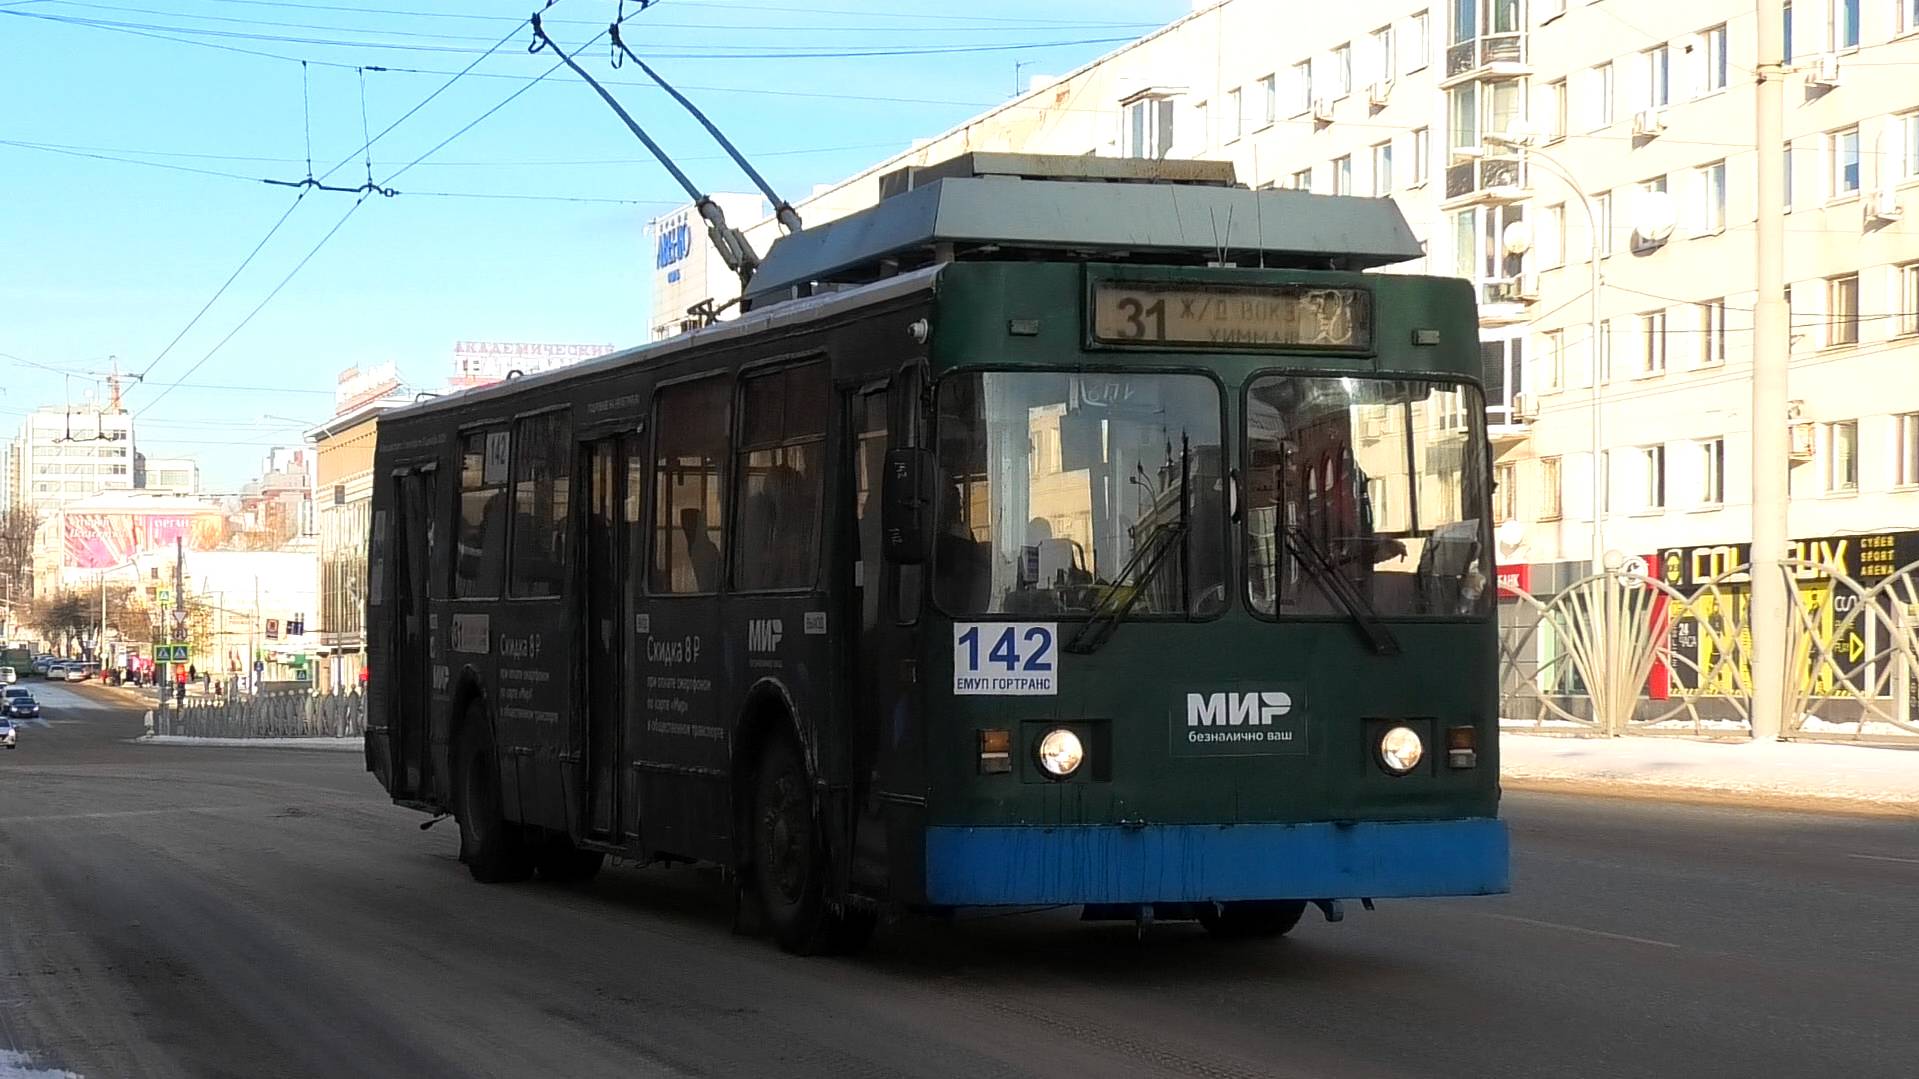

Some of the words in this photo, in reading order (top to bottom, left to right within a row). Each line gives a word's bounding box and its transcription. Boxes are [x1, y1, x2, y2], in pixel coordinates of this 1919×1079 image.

[1117, 297, 1167, 341] 31
[1241, 300, 1308, 323] ВОКЗ
[1860, 536, 1894, 548] CYBER
[1860, 550, 1894, 562] SPORT
[1860, 564, 1894, 576] ARENA
[748, 619, 783, 652] МИР
[647, 635, 683, 667] Скидка
[685, 635, 692, 663] 8
[957, 626, 1053, 672] 142
[957, 677, 990, 690] ЕМУП
[993, 677, 1051, 690] ГОРТРАНС
[1187, 692, 1292, 726] МИР
[1188, 730, 1264, 743] безналично
[1267, 730, 1293, 742] ваш
